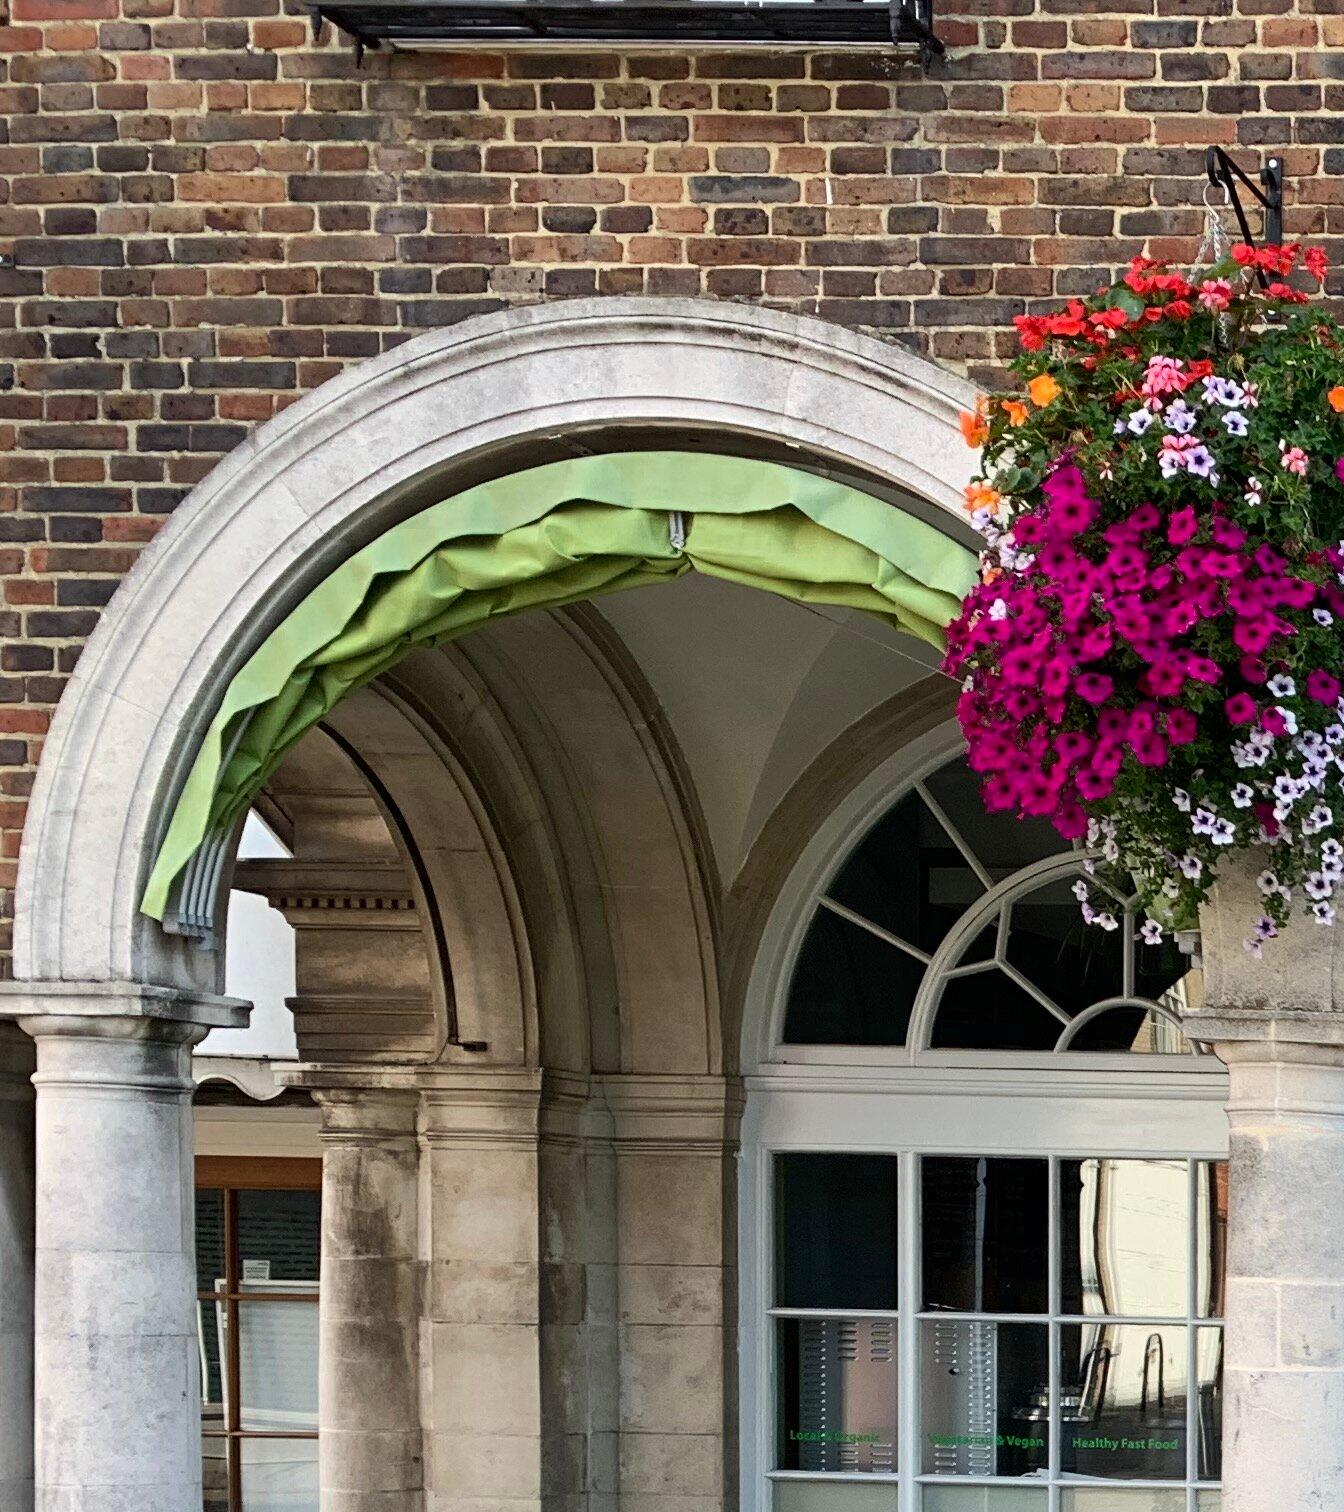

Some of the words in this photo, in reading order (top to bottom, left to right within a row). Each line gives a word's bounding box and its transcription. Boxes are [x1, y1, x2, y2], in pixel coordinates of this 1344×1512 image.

[1006, 1435, 1044, 1449] Vegan
[1072, 1437, 1119, 1450] Healthy
[1121, 1438, 1146, 1449] Fast
[1148, 1438, 1179, 1449] Food
